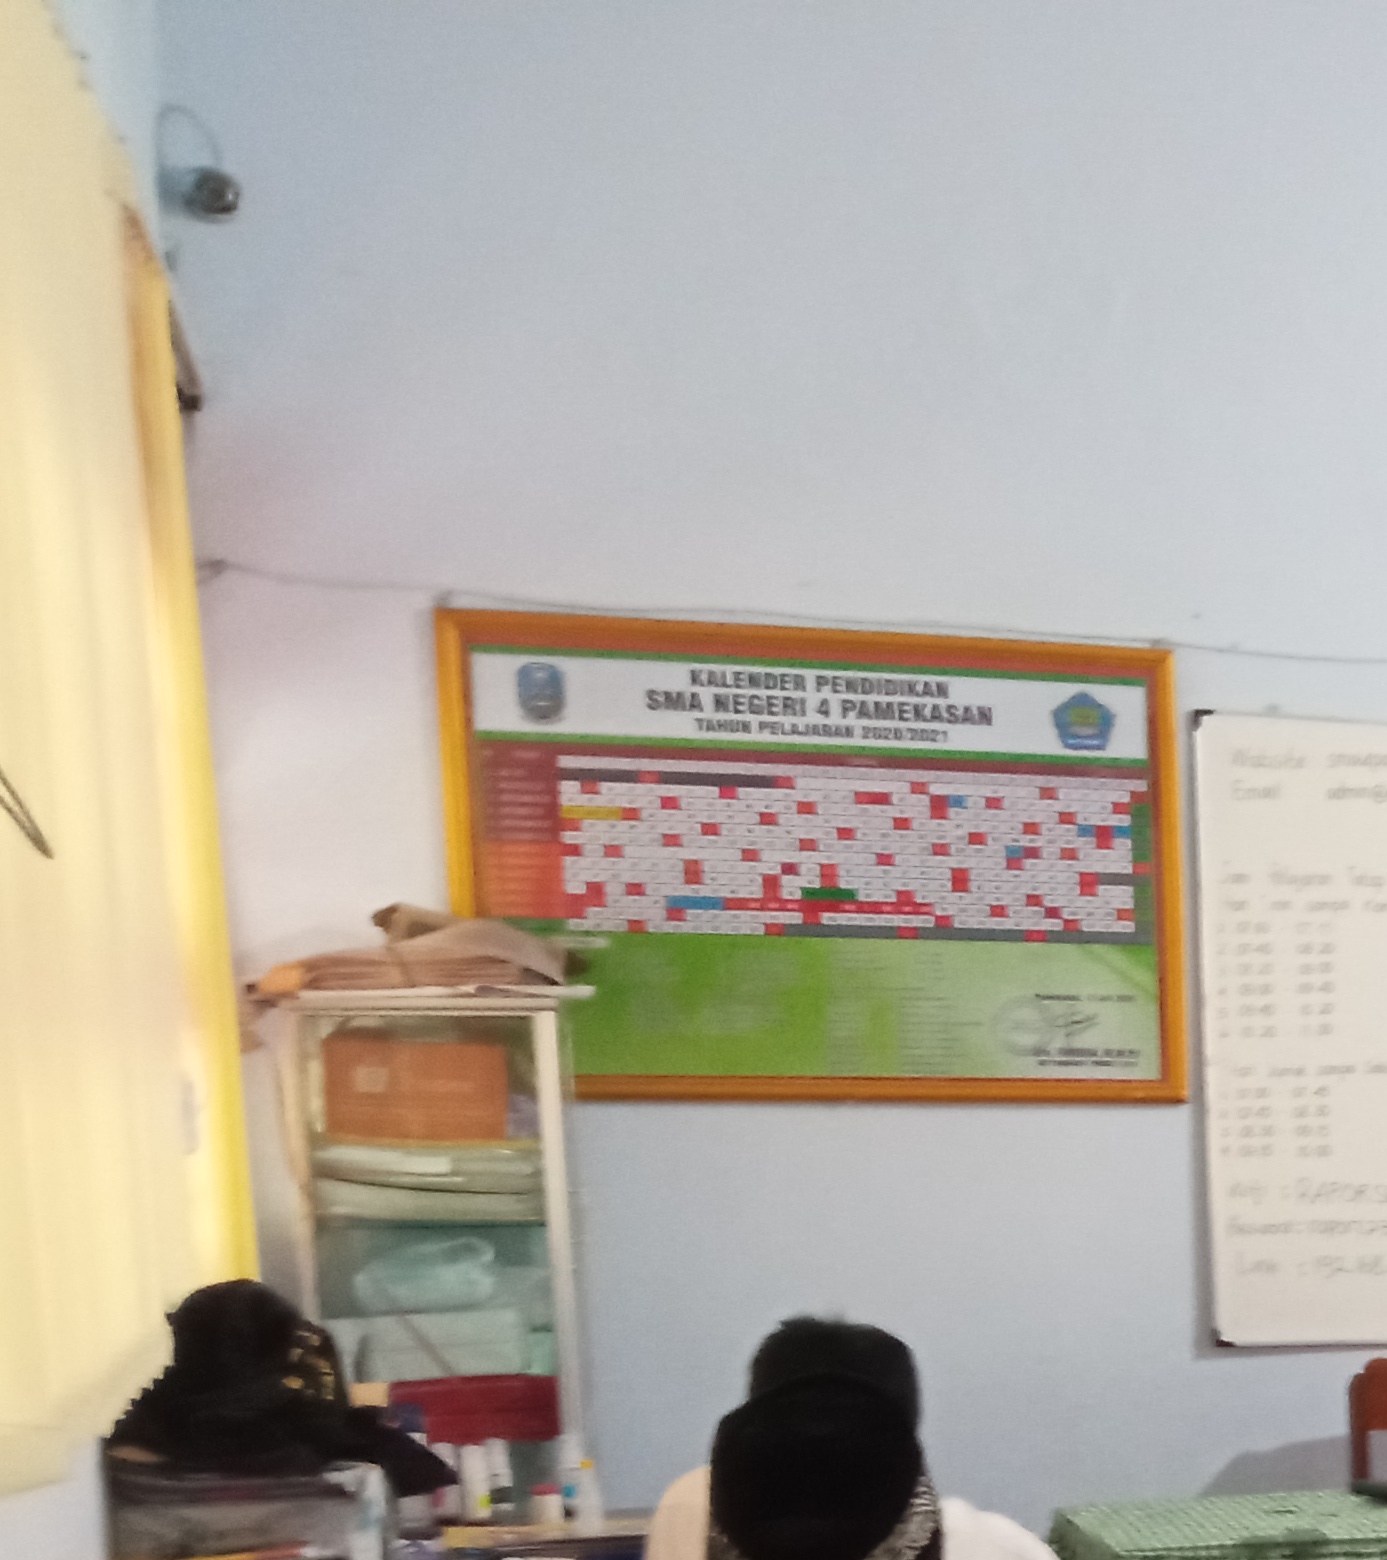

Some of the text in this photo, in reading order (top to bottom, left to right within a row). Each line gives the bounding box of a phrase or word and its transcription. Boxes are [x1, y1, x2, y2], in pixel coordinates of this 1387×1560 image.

[689, 669, 949, 698] KALENDER PENDIDIKAN
[646, 690, 993, 726] SMA NEGERI 4 PAMEKASAN
[696, 718, 751, 734] TAHUN
[758, 721, 854, 738] PELAJARAN
